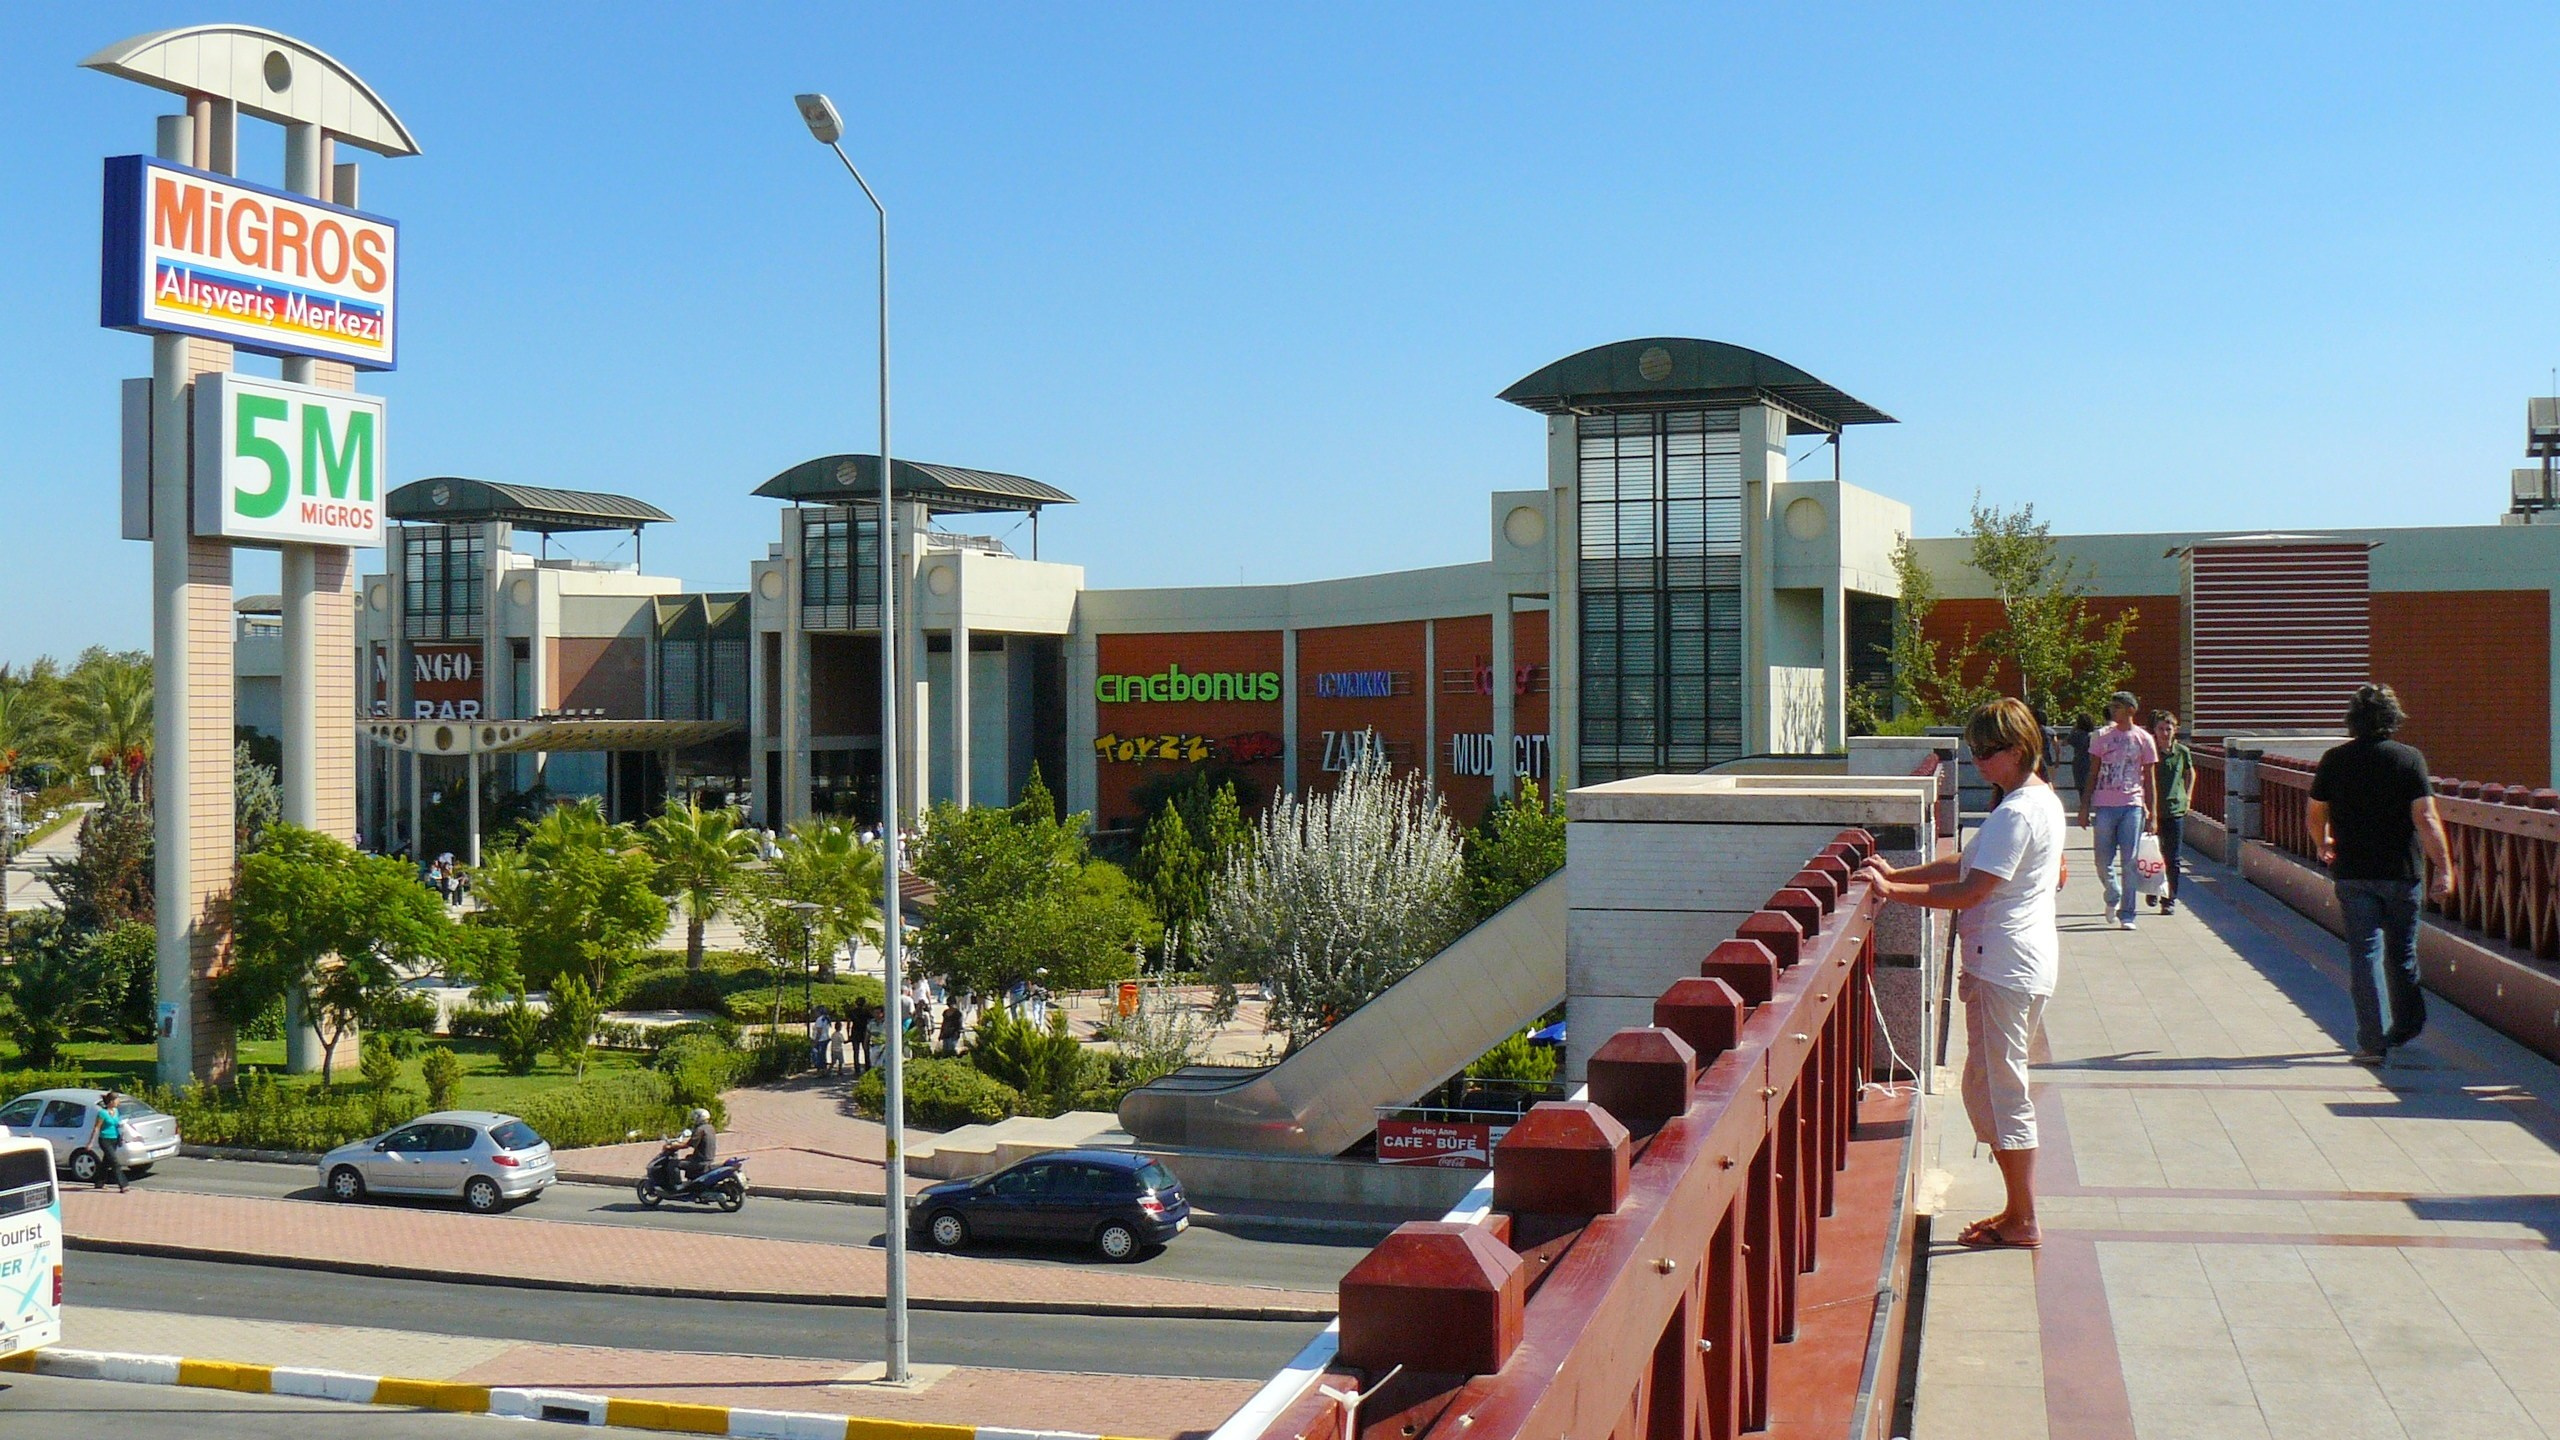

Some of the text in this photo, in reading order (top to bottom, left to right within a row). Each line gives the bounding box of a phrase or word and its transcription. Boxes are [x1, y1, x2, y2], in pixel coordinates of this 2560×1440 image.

[160, 265, 383, 342] Alışveriş Merkezi
[234, 392, 374, 519] 5M
[1321, 731, 1386, 773] ZARA
[1383, 1136, 1423, 1148] CAFE
[0, 1223, 42, 1247] ourist
